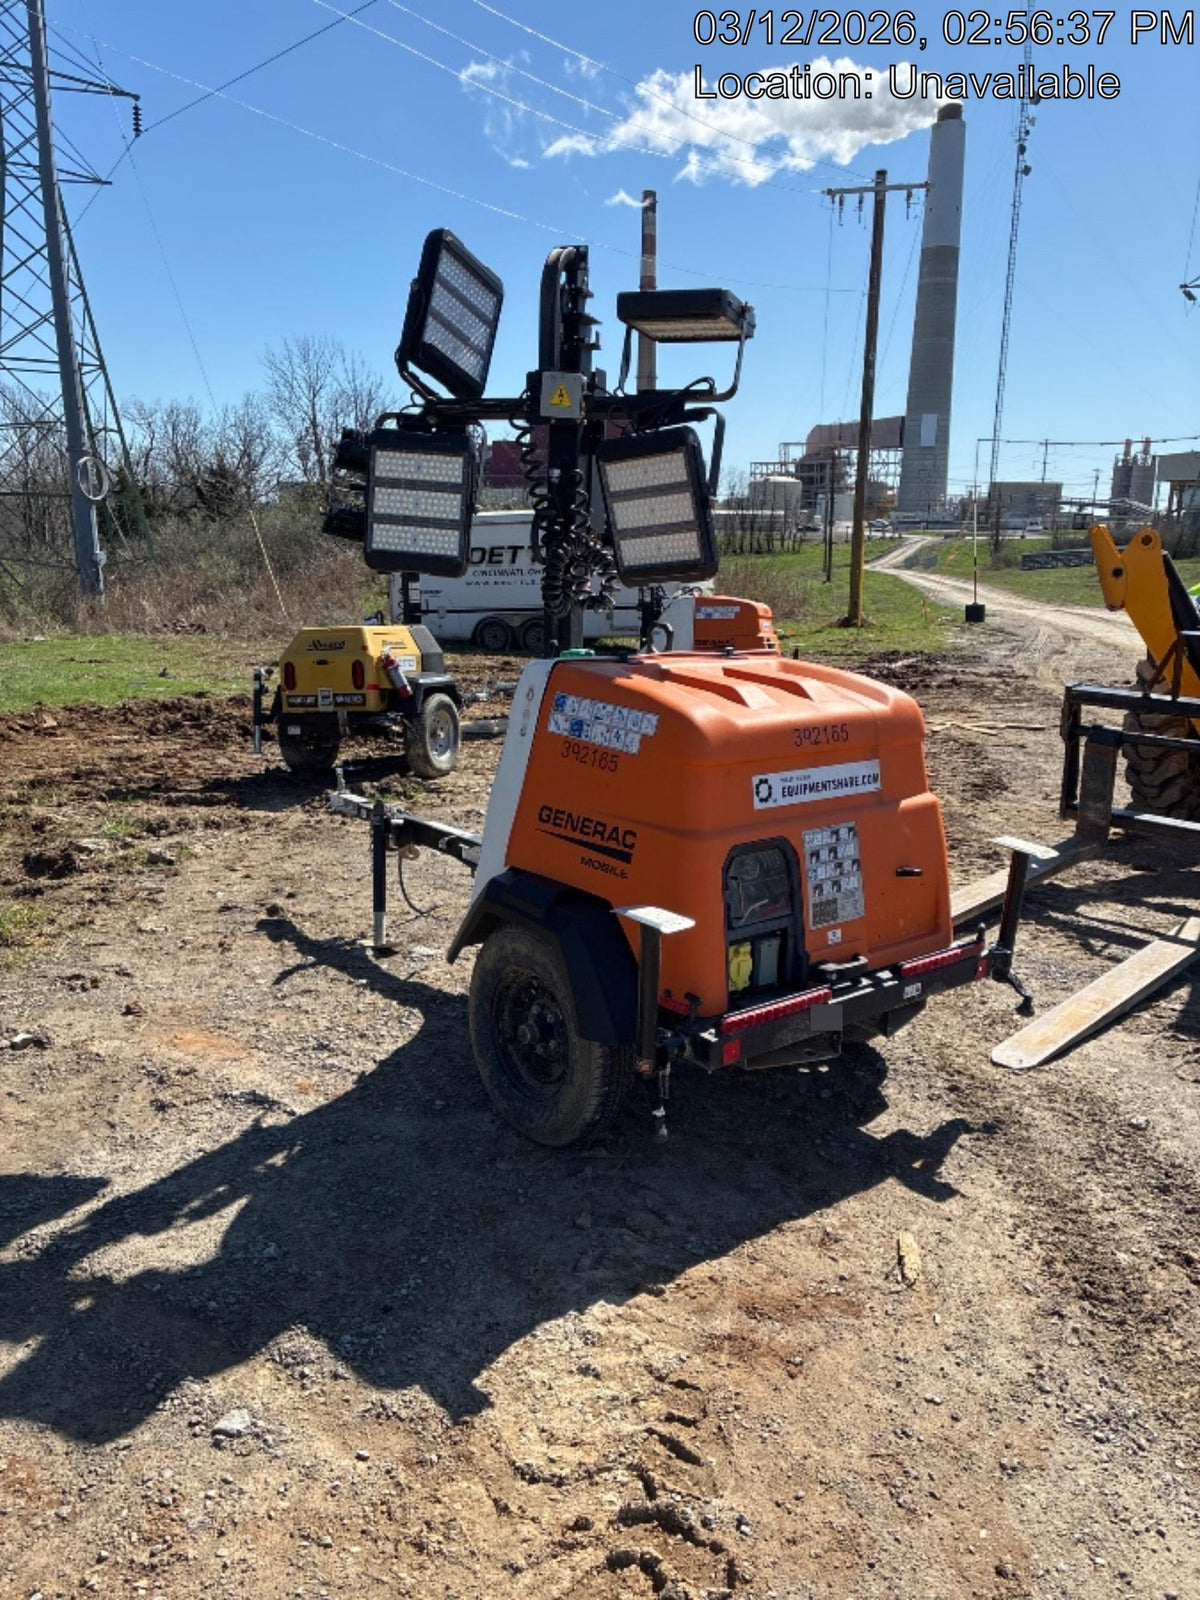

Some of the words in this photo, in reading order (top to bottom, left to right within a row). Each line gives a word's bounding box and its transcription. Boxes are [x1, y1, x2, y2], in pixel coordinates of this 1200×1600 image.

[793, 723, 849, 748] 392165
[561, 741, 620, 773] 392165
[781, 772, 880, 799] EQUIPMENTSHARE.COM
[538, 804, 637, 851] GENERAC
[580, 856, 629, 880] MOBILE
